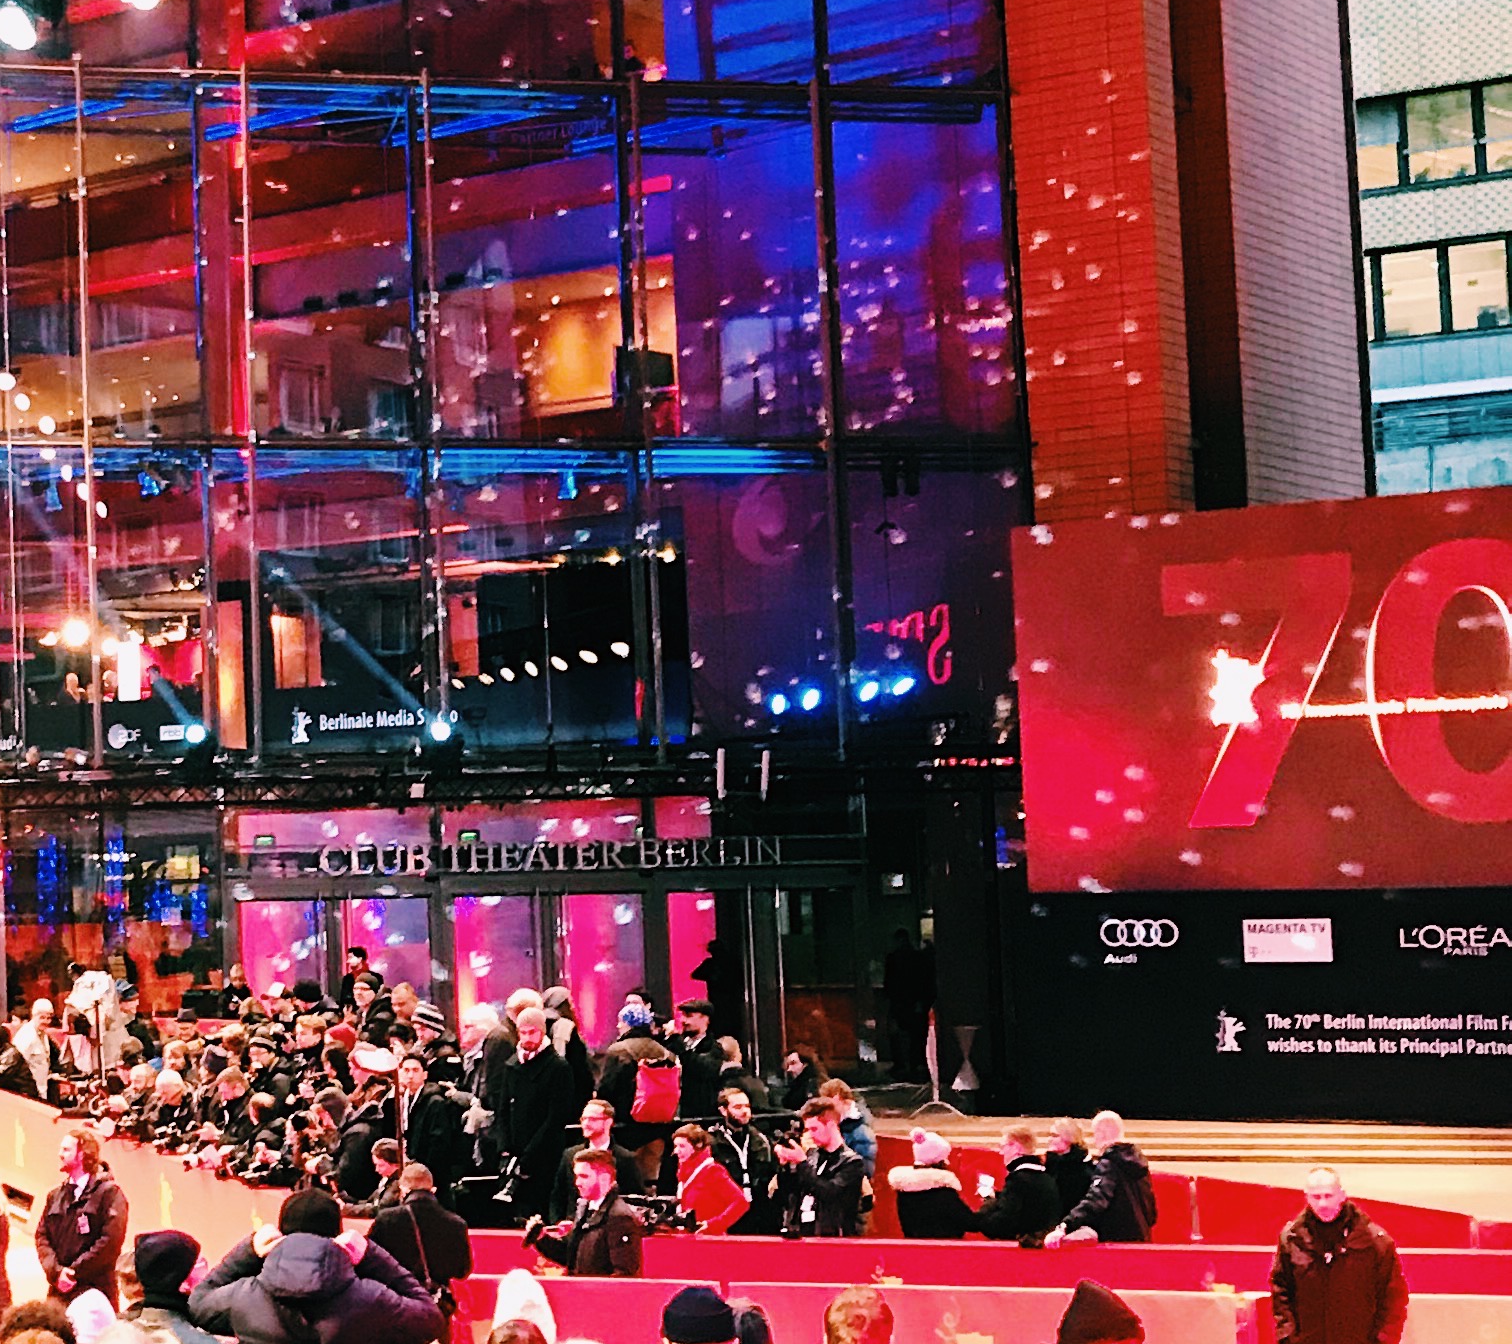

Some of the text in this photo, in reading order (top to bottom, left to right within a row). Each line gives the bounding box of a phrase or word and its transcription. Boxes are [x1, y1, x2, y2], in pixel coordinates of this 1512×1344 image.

[1161, 537, 1512, 829] 70
[319, 711, 374, 731] Berlinale
[376, 709, 415, 729] Media
[318, 836, 782, 876] CLUB THEATER BERLIN
[1247, 923, 1326, 934] MAGENTA TV
[1103, 953, 1138, 964] Audi
[1443, 947, 1489, 957] PARIS
[1265, 1013, 1292, 1030] The
[1323, 1014, 1366, 1031] Berlin
[1368, 1014, 1463, 1031] International
[1466, 1014, 1498, 1032] Film
[1267, 1037, 1315, 1053] wishes
[1317, 1038, 1333, 1053] to
[1335, 1038, 1377, 1054] thank
[1379, 1038, 1398, 1054] its
[1400, 1038, 1463, 1058] Principal
